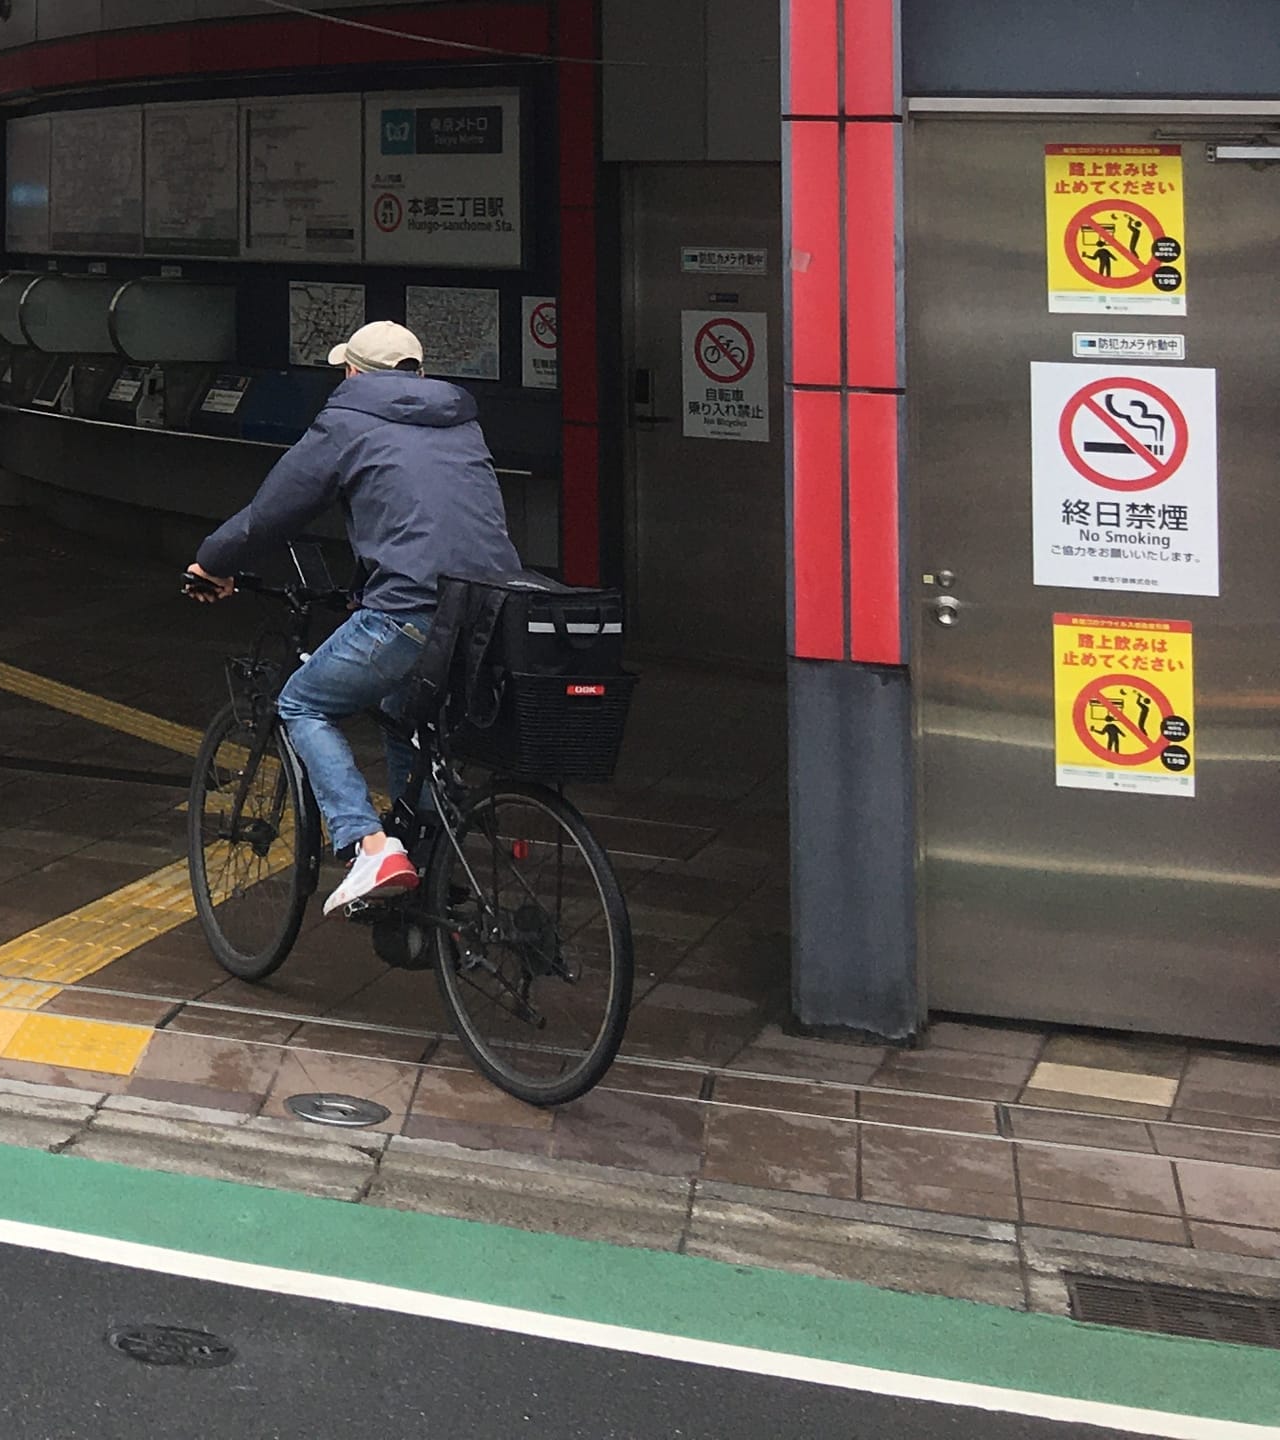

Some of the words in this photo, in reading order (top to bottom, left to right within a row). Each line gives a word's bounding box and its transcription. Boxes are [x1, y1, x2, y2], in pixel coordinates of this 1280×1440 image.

[1068, 161, 1159, 177] 路上飲みは
[1053, 180, 1175, 195] 止めてください
[408, 196, 504, 217] 本郷三丁目駅
[1098, 337, 1178, 351] 防犯カメラ作動中
[706, 388, 744, 401] 自転車
[688, 401, 764, 419] 乗り入れ禁止
[1061, 498, 1189, 532] 終日禁煙
[1079, 529, 1100, 542] No
[1105, 530, 1171, 549] Smoking
[1051, 544, 1201, 563] ご協力をお願いいたします。
[1077, 633, 1168, 653] 路上飲みは
[1062, 650, 1185, 672] 止めてください
